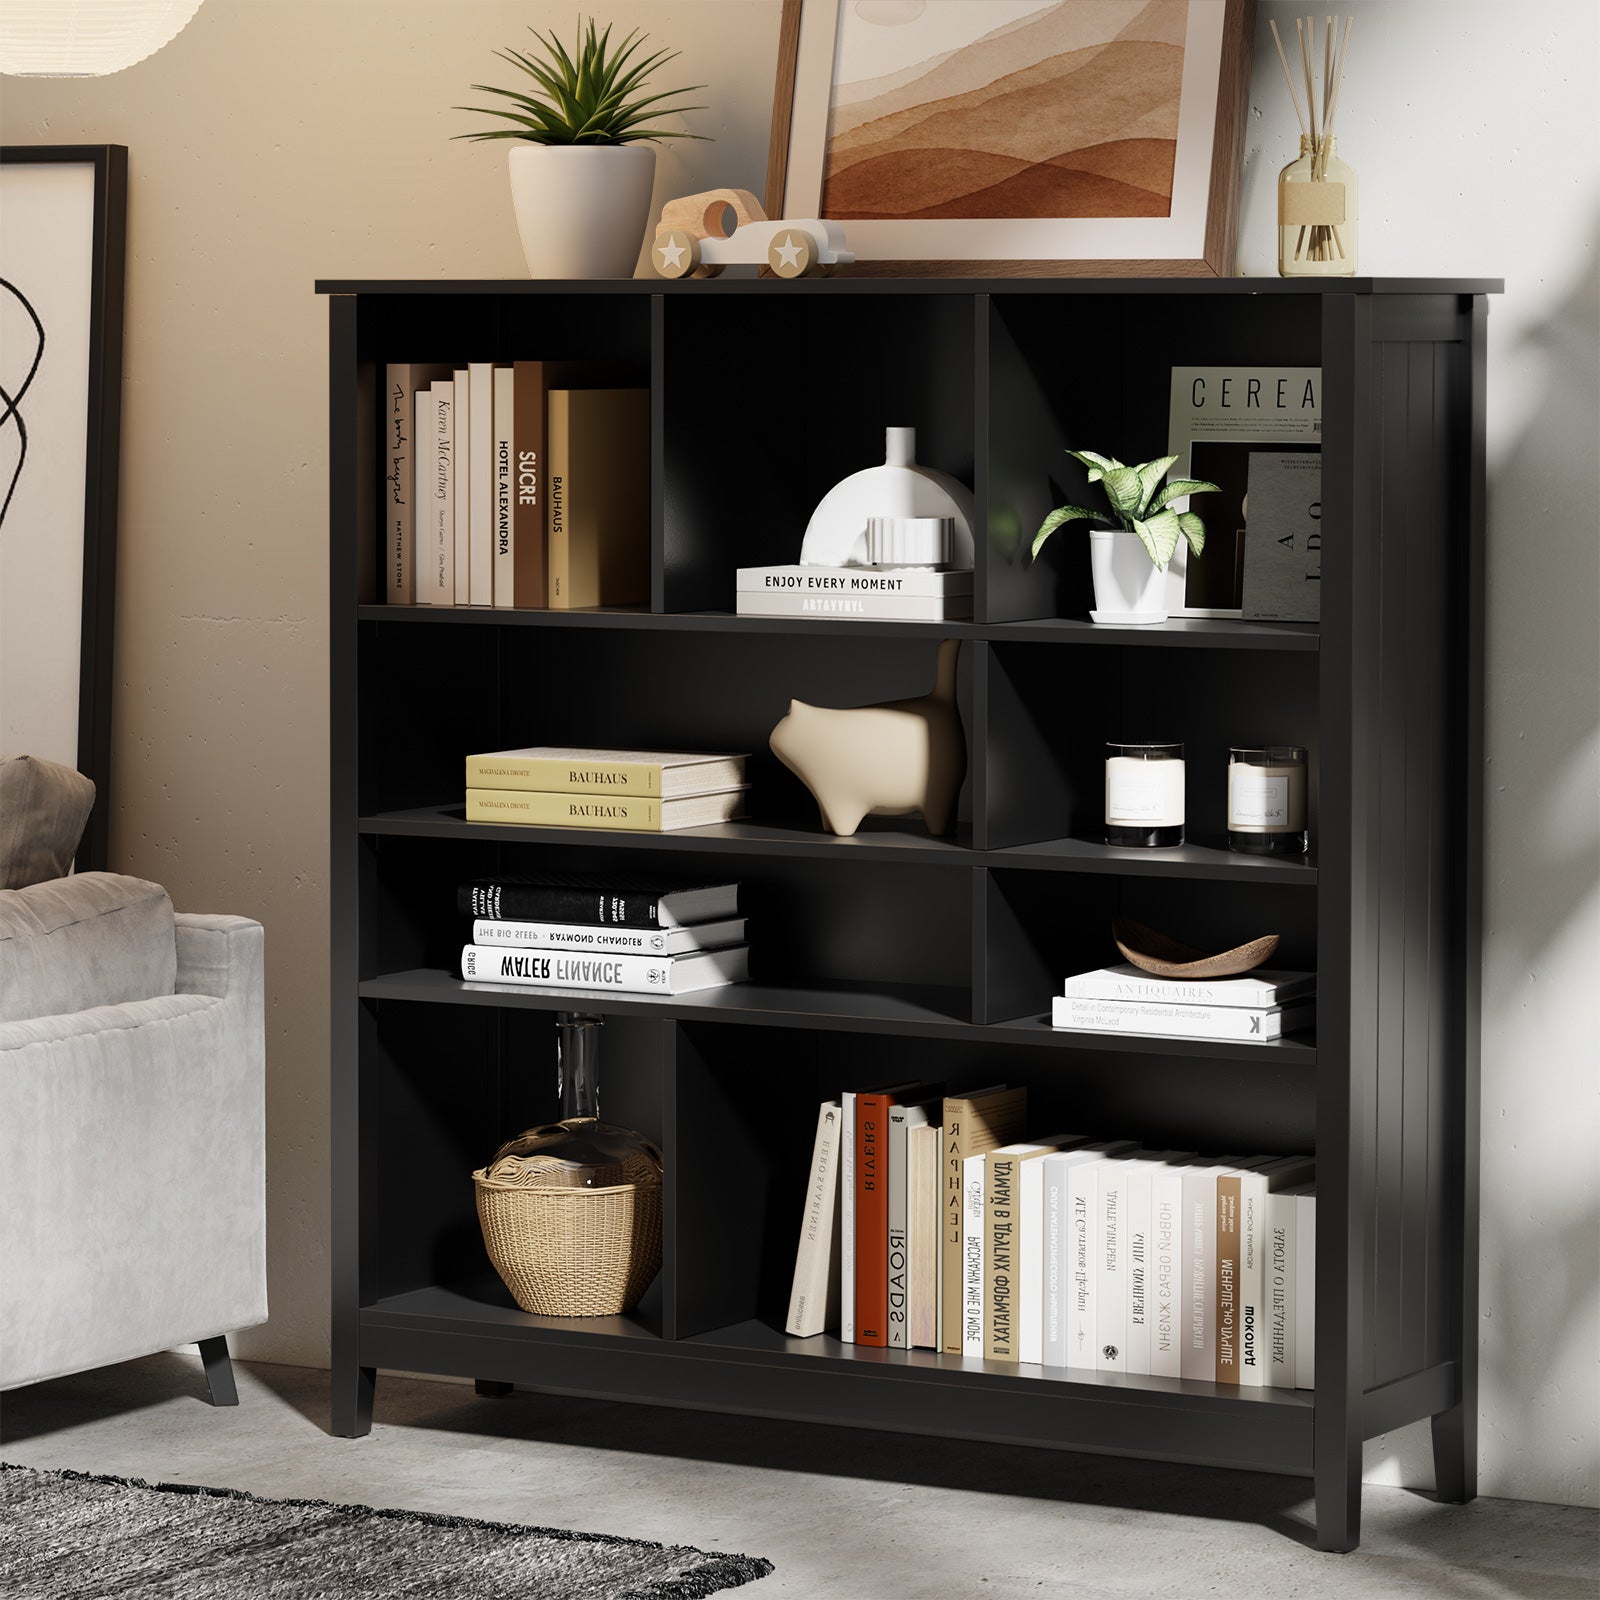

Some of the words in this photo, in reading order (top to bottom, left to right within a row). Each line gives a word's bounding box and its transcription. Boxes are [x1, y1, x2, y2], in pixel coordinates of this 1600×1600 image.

[392, 383, 405, 413] The
[1192, 377, 1315, 408] CEREA
[392, 417, 408, 450] body
[438, 400, 451, 435] Karen
[436, 437, 451, 501] McCartney
[499, 440, 509, 480] HOTEL
[386, 456, 406, 505] beyond
[518, 450, 537, 506] SUCRE
[499, 481, 509, 555] ALEXANDRA
[552, 476, 563, 533] BAUHAUS
[765, 575, 803, 588] ENJOY
[807, 577, 846, 589] EVERY
[851, 578, 903, 590] MOMENT
[568, 771, 628, 785] BAUHAUS
[568, 804, 628, 818] BAUHAUS
[1115, 983, 1214, 998] ANTIQUAIRES
[1071, 1001, 1089, 1011] Detail
[1089, 1003, 1095, 1011] in
[1096, 1003, 1138, 1017] Contemporary
[1140, 1005, 1173, 1017] Residential
[1175, 1008, 1211, 1020] Architecture
[1071, 1015, 1096, 1026] Virginia
[1096, 1016, 1120, 1027] McLeod
